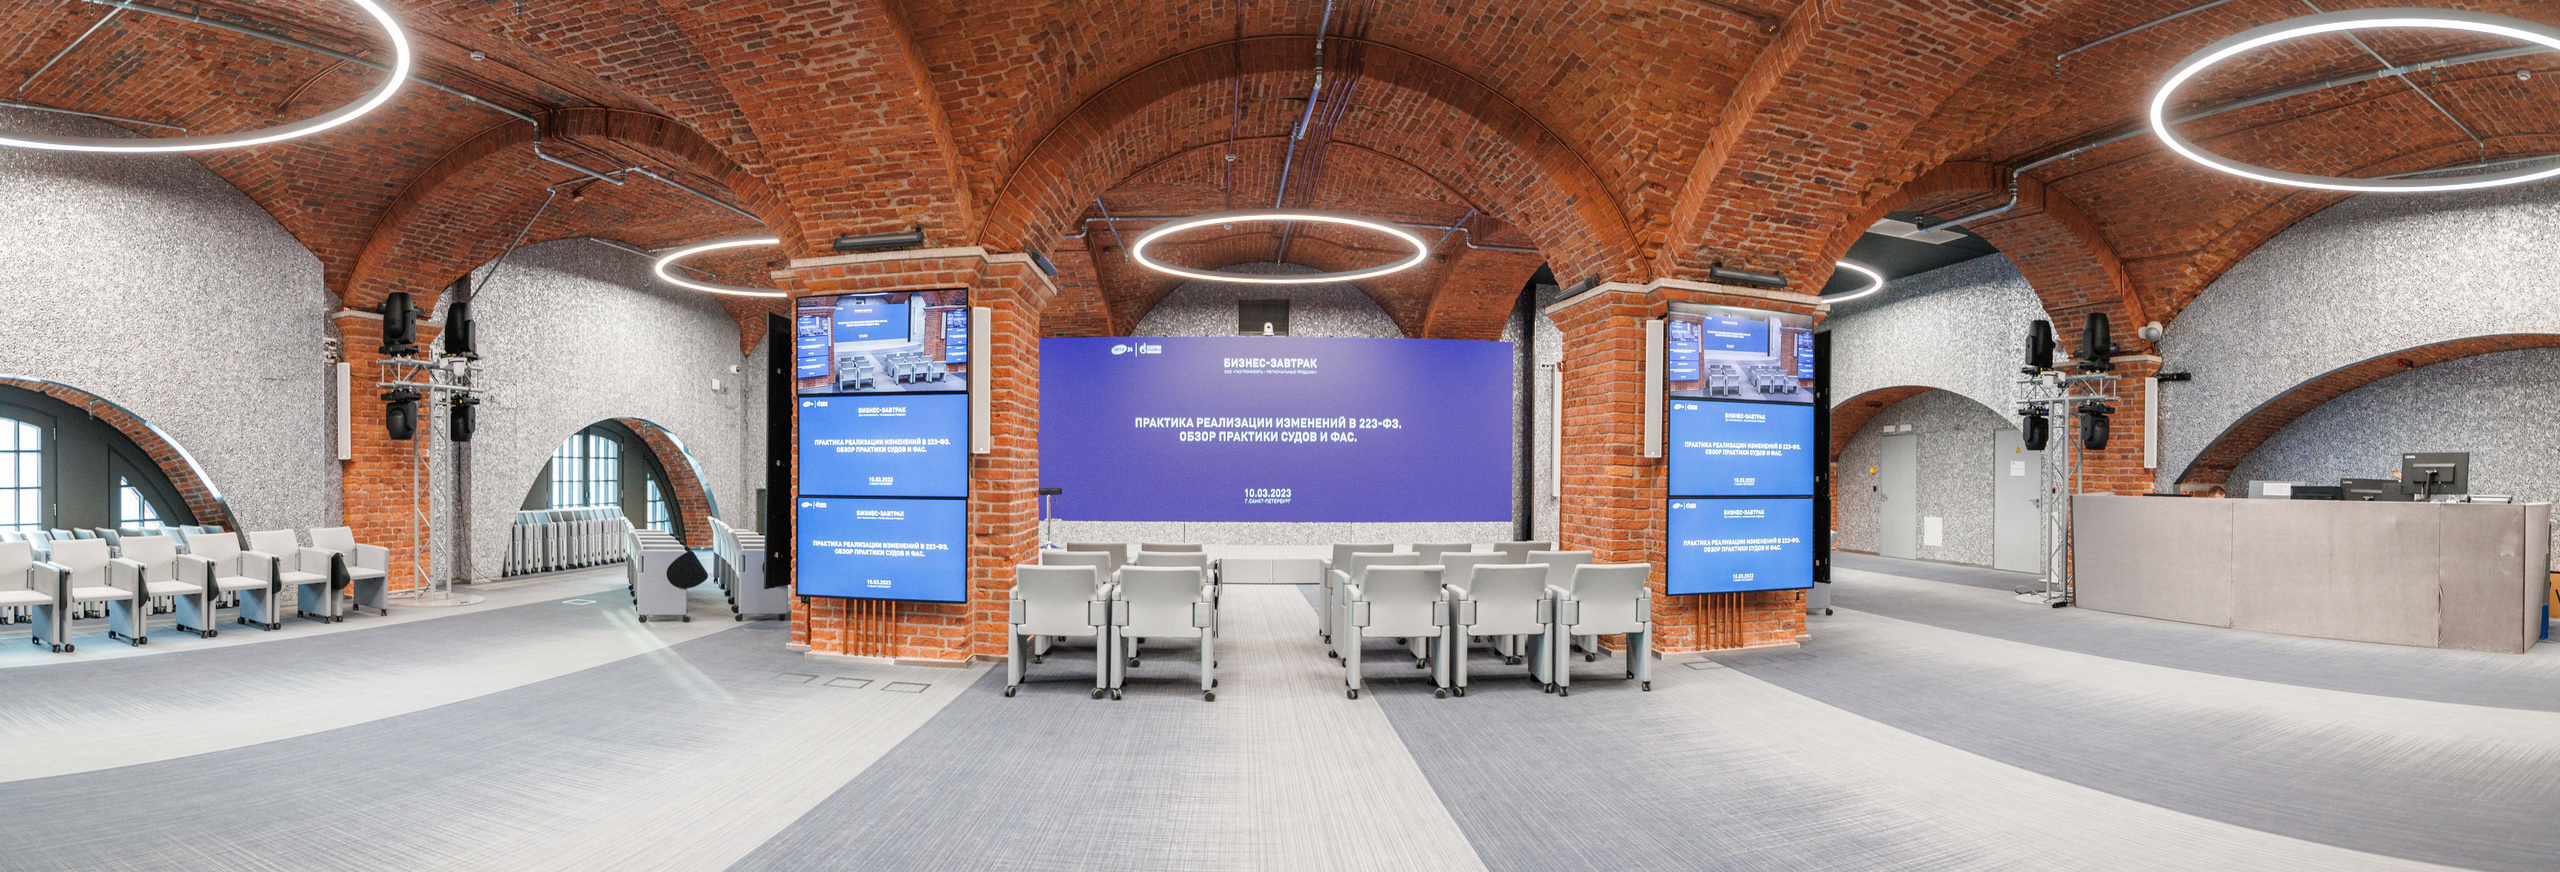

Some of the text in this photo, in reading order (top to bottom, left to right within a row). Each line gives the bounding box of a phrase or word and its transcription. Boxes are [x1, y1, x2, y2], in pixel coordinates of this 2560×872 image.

[1224, 358, 1318, 368] БИЗНЕС-ЗАВТРАК
[1135, 416, 1402, 429] ПРАКТИКА РЕАЛИЗАЦИИ ИЗМЕНЕНИЙ В 223-ФЗ.
[1180, 431, 1357, 443] ОБЗОР ПРАКТИКИ СУДОВ И ФАС.
[1245, 488, 1292, 498] 10.03.2023
